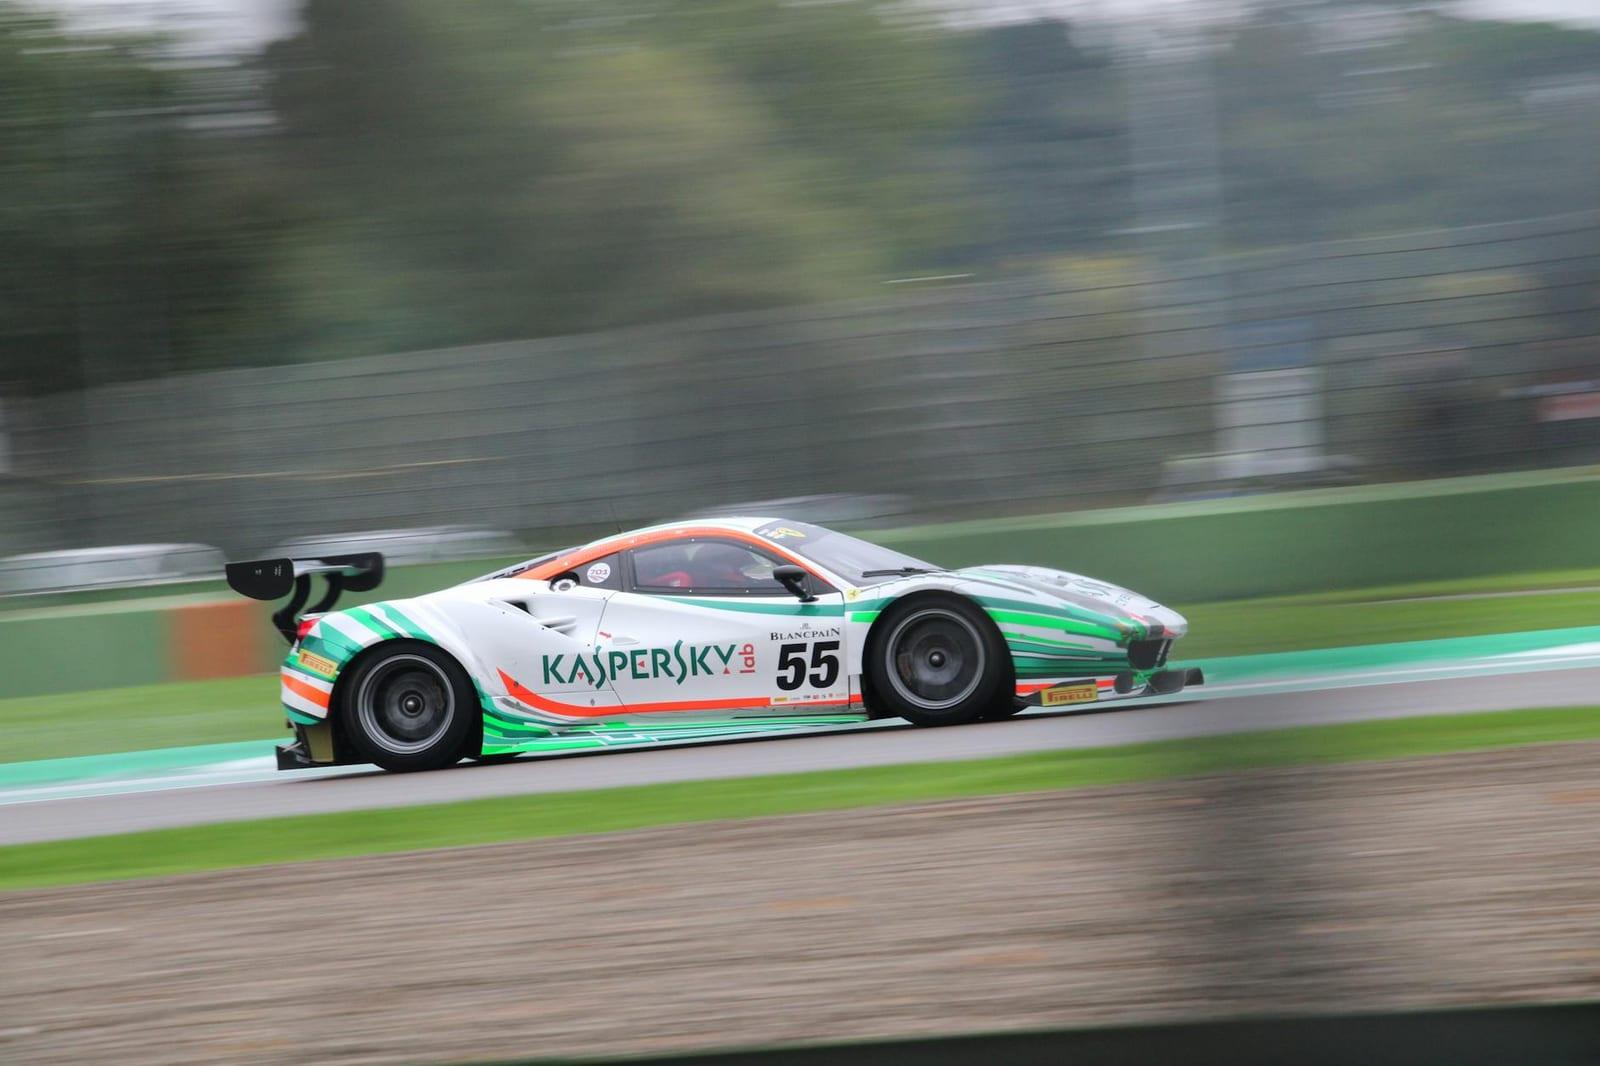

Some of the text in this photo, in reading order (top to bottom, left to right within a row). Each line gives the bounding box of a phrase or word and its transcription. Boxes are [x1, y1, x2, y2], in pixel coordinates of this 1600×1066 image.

[770, 627, 841, 640] BLANCPAIN
[542, 640, 756, 690] KASPERSKY lab
[776, 640, 841, 691] 55
[1047, 687, 1092, 702] PIRELLI
